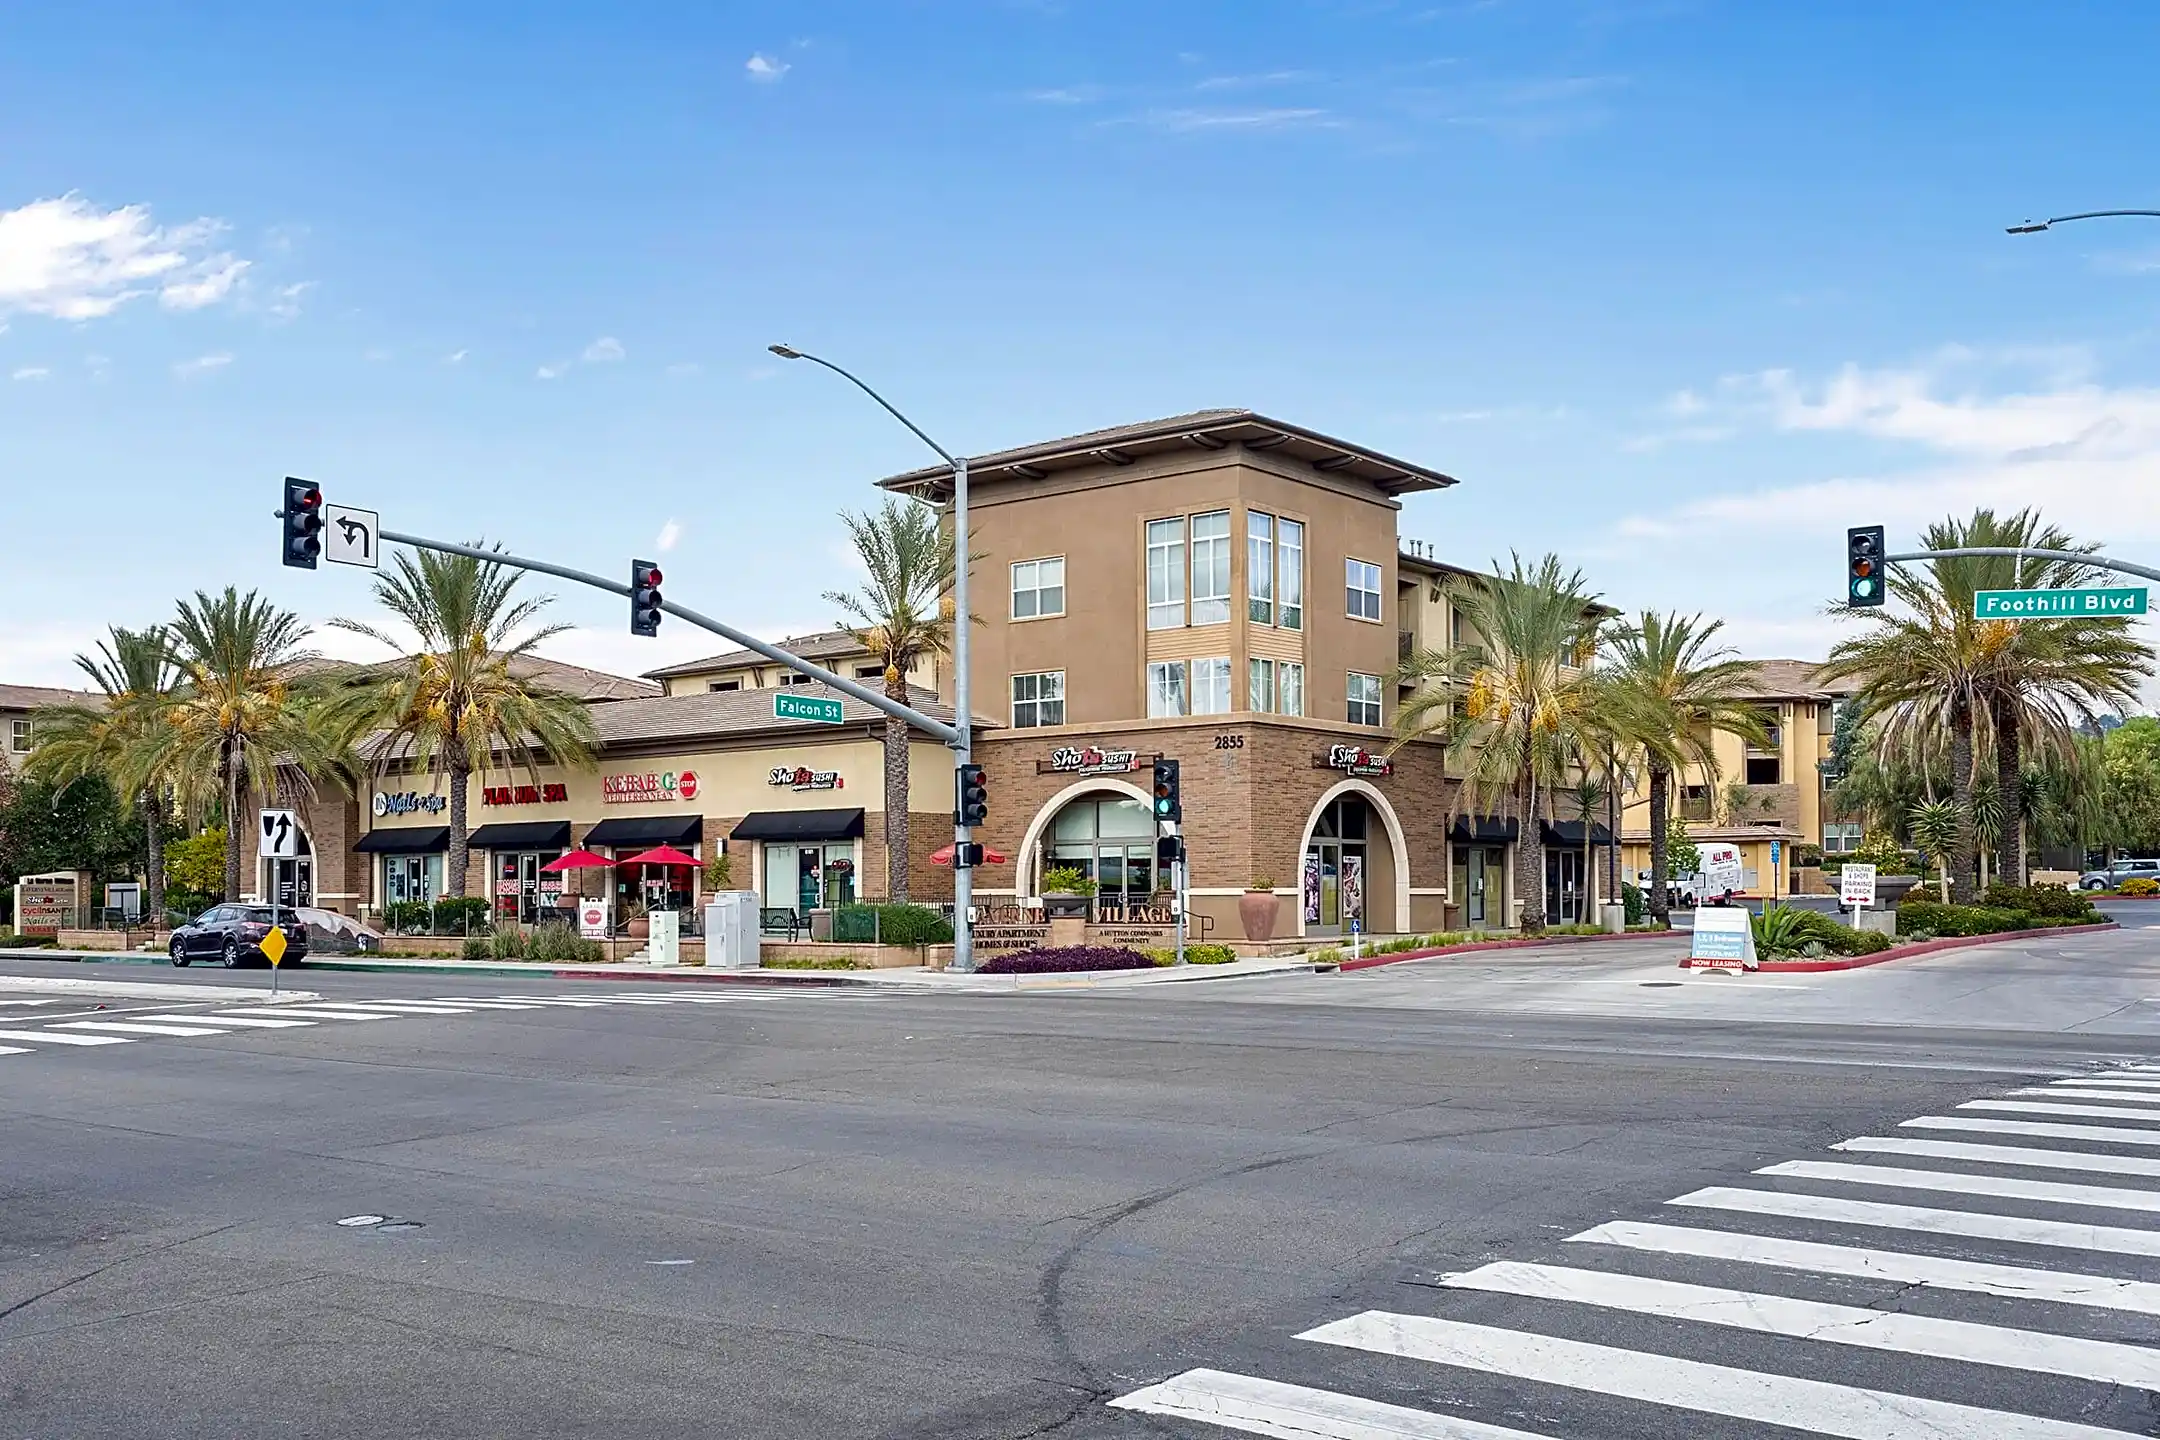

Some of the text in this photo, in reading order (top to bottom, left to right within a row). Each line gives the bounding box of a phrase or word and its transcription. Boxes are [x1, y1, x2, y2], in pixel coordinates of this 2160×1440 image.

[1986, 594, 2135, 612] Foothill Blvd
[780, 699, 838, 718] Falcon St
[1214, 735, 1244, 749] 2855
[1102, 754, 1130, 764] SUSHI
[603, 772, 695, 793] KEBAB G STOP
[811, 772, 835, 782] SUSHI
[543, 783, 569, 802] SPA
[386, 792, 417, 813] Nails
[1094, 906, 1172, 923] VILLAGE
[997, 928, 1048, 938] APARTMENT
[975, 940, 1002, 949] HOMES
[1691, 959, 1742, 969] NOW LEASING
